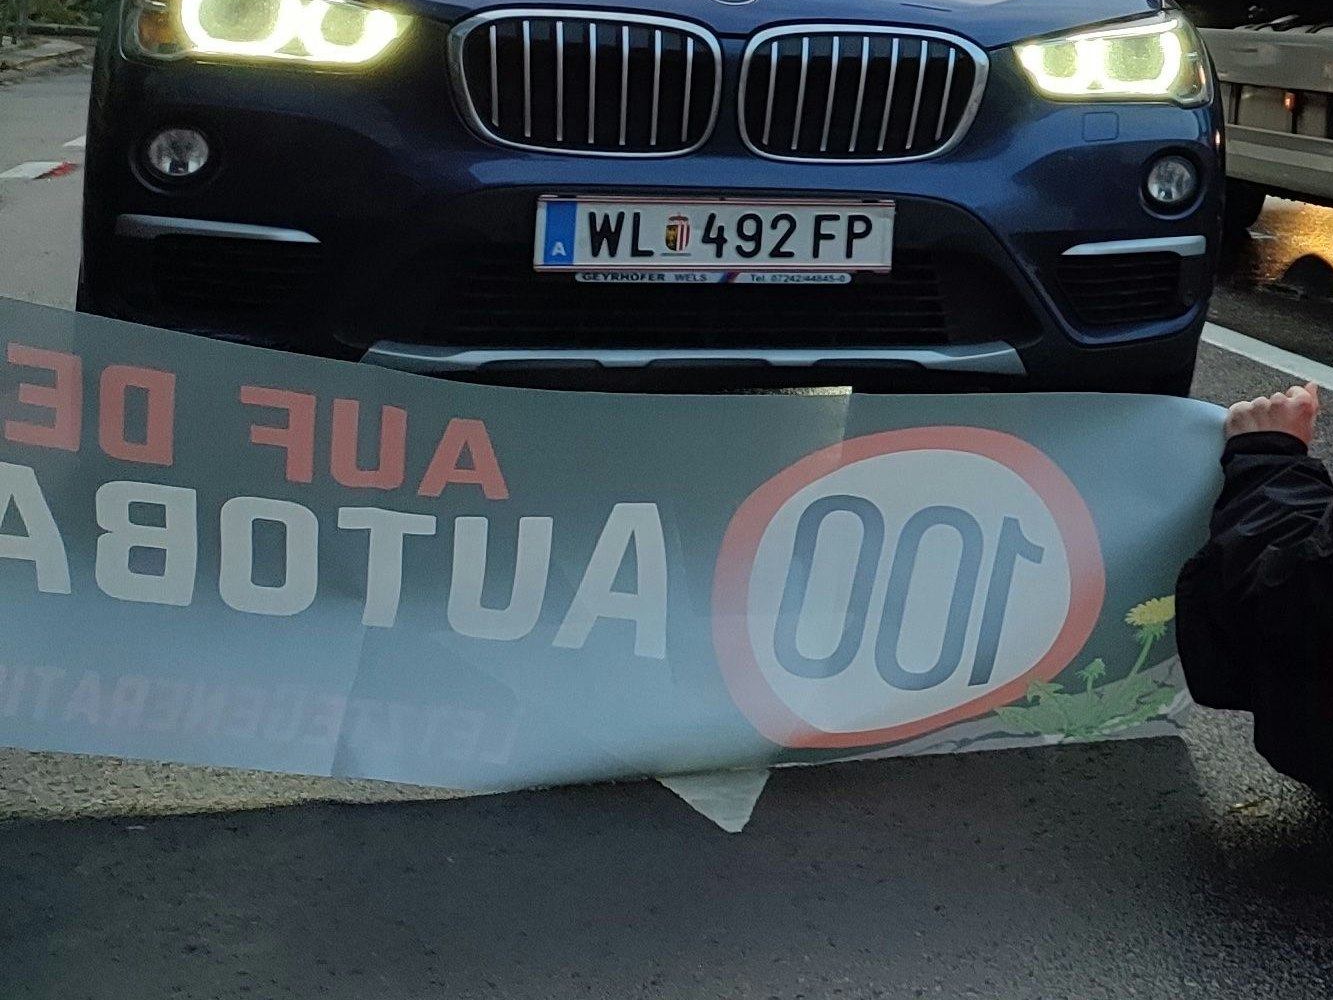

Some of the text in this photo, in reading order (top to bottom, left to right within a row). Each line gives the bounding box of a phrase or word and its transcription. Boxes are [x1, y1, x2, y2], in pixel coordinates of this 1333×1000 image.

[551, 211, 873, 259] A WL 492 FP
